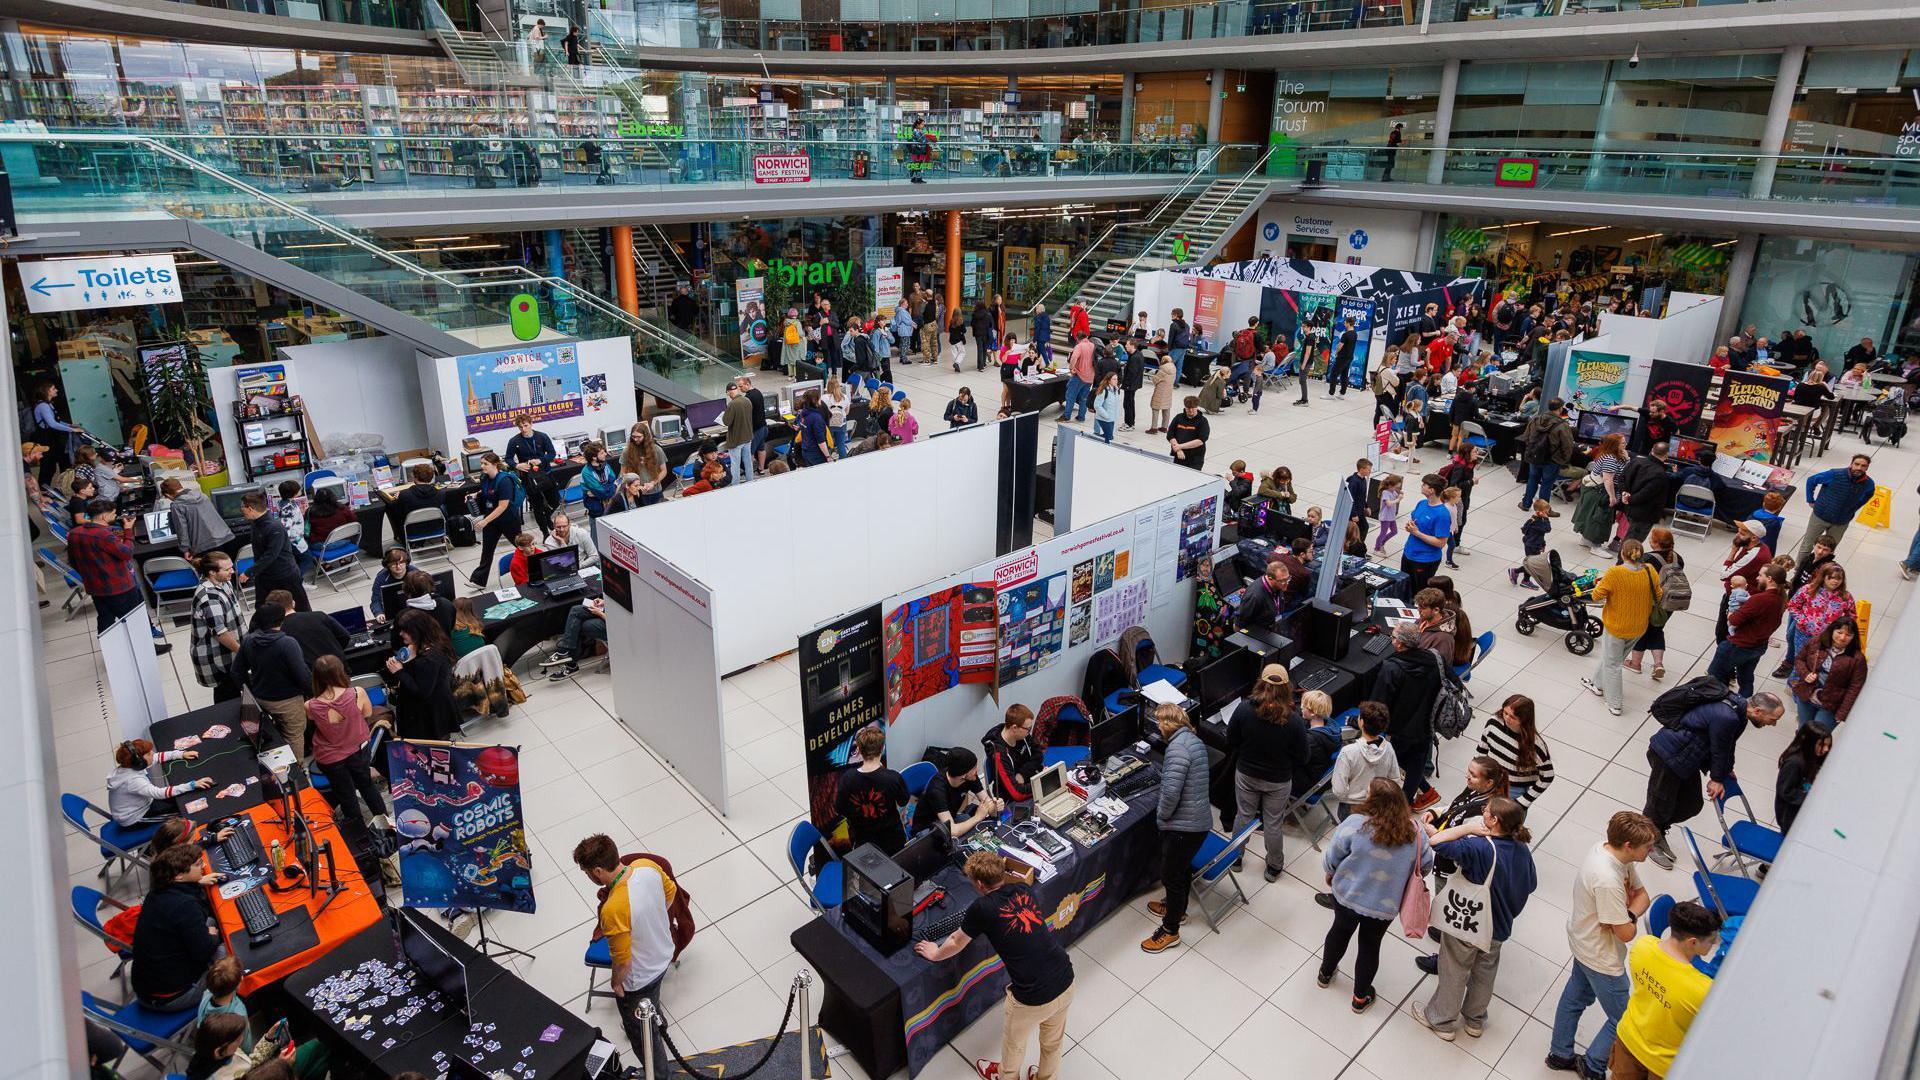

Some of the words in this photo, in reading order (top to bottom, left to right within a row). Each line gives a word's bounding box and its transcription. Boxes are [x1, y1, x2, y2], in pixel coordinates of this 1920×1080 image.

[1279, 80, 1304, 95] The
[1276, 98, 1324, 113] Forum
[618, 120, 683, 139] Library
[1274, 117, 1308, 132] Trust
[1896, 145, 1916, 155] for
[757, 159, 807, 169] NORWICH
[1294, 215, 1333, 226] Customer
[1295, 225, 1329, 235] Services
[78, 267, 172, 287] Toilets
[1396, 304, 1420, 319] XIST
[496, 352, 541, 365] NORWICH
[1576, 361, 1621, 375] ILLUSION
[1580, 371, 1621, 384] ISLAND
[1728, 384, 1780, 402] ILLUSION
[1731, 394, 1776, 410] ISLAND
[475, 411, 507, 423] PLAYING
[509, 409, 526, 418] WITH
[528, 406, 546, 415] PURE
[548, 401, 574, 411] ENERGY
[1061, 527, 1125, 555] norwichgamesfestival.co.uk
[611, 541, 637, 560] NORWICH
[996, 558, 1036, 580] NORWICH
[1015, 568, 1036, 579] FESTIVAL
[821, 636, 833, 648] EN
[829, 696, 864, 724] GAMES
[809, 703, 883, 751] DEVELOPMENT
[453, 793, 510, 827] COSMIC
[455, 805, 514, 840] ROBOTS
[1642, 968, 1666, 993] Here
[1635, 973, 1644, 985] to
[1648, 984, 1671, 1009] help
